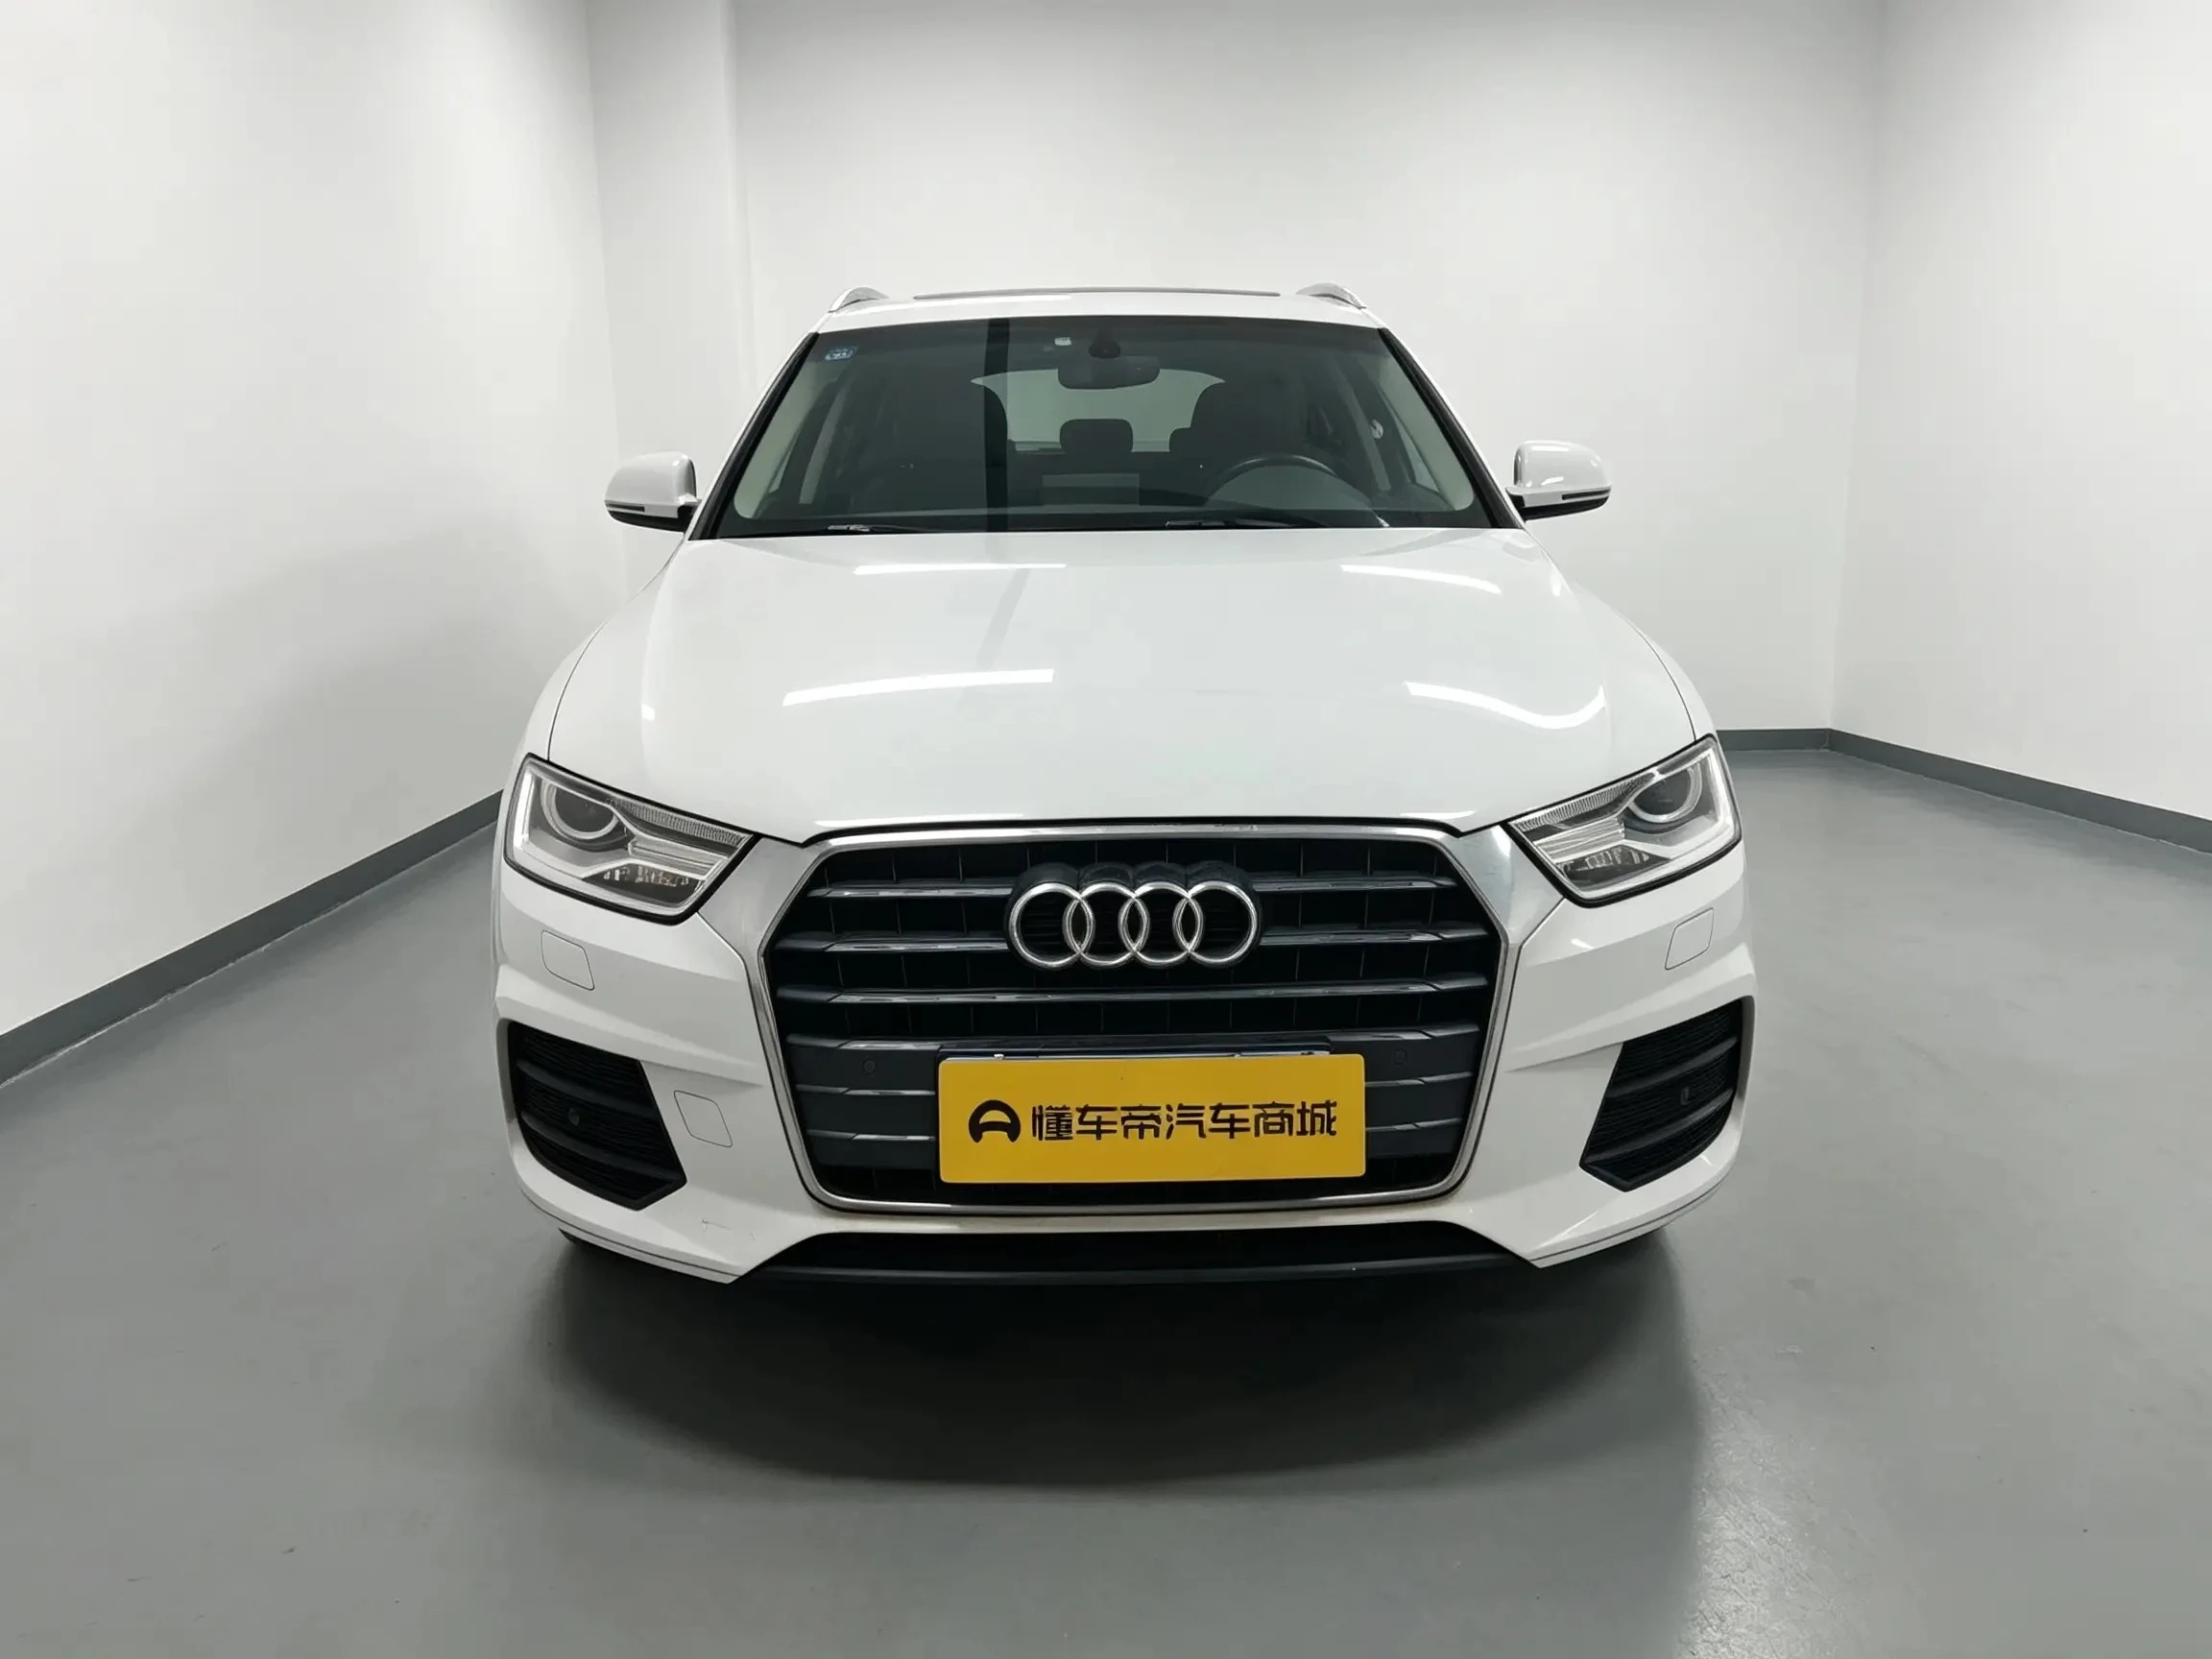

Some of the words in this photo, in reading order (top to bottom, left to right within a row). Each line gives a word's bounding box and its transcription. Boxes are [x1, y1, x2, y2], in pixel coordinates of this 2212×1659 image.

[1032, 1100, 1336, 1141] 懂车帝汽车商城
